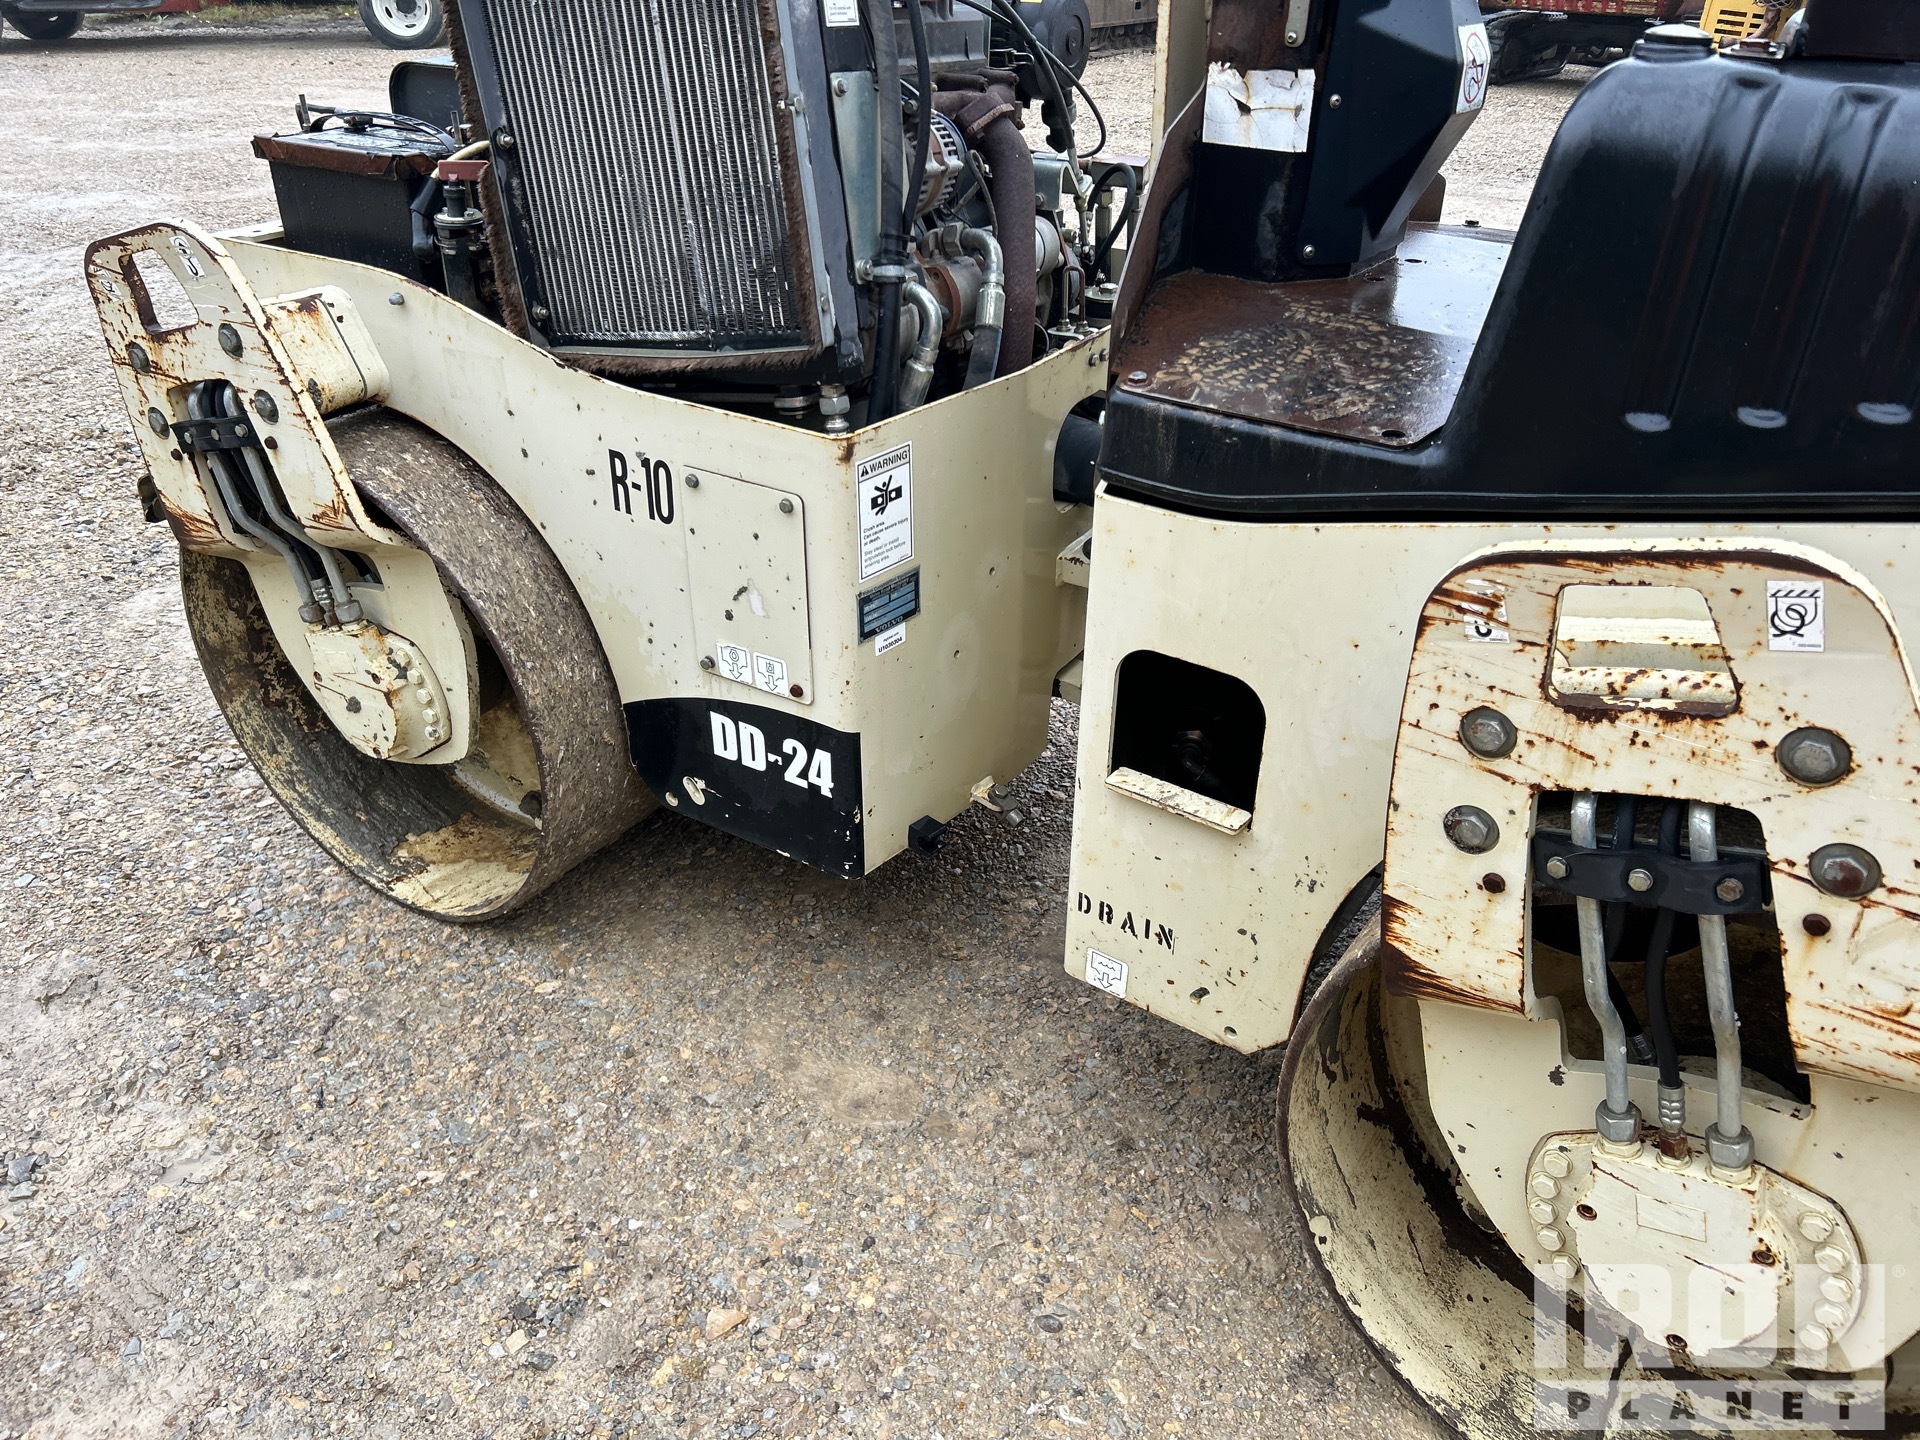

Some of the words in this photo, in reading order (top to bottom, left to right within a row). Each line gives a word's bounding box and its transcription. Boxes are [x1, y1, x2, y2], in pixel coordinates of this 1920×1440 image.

[870, 450, 908, 473] WARNING
[608, 448, 674, 524] R-10
[864, 525, 875, 533] Crush
[872, 528, 884, 536] cause
[884, 522, 897, 530] severe
[898, 517, 908, 525] injury
[894, 541, 906, 549] before
[875, 616, 903, 632] VOLVO
[710, 710, 834, 798] DD-24
[1078, 892, 1174, 951] DRAIN
